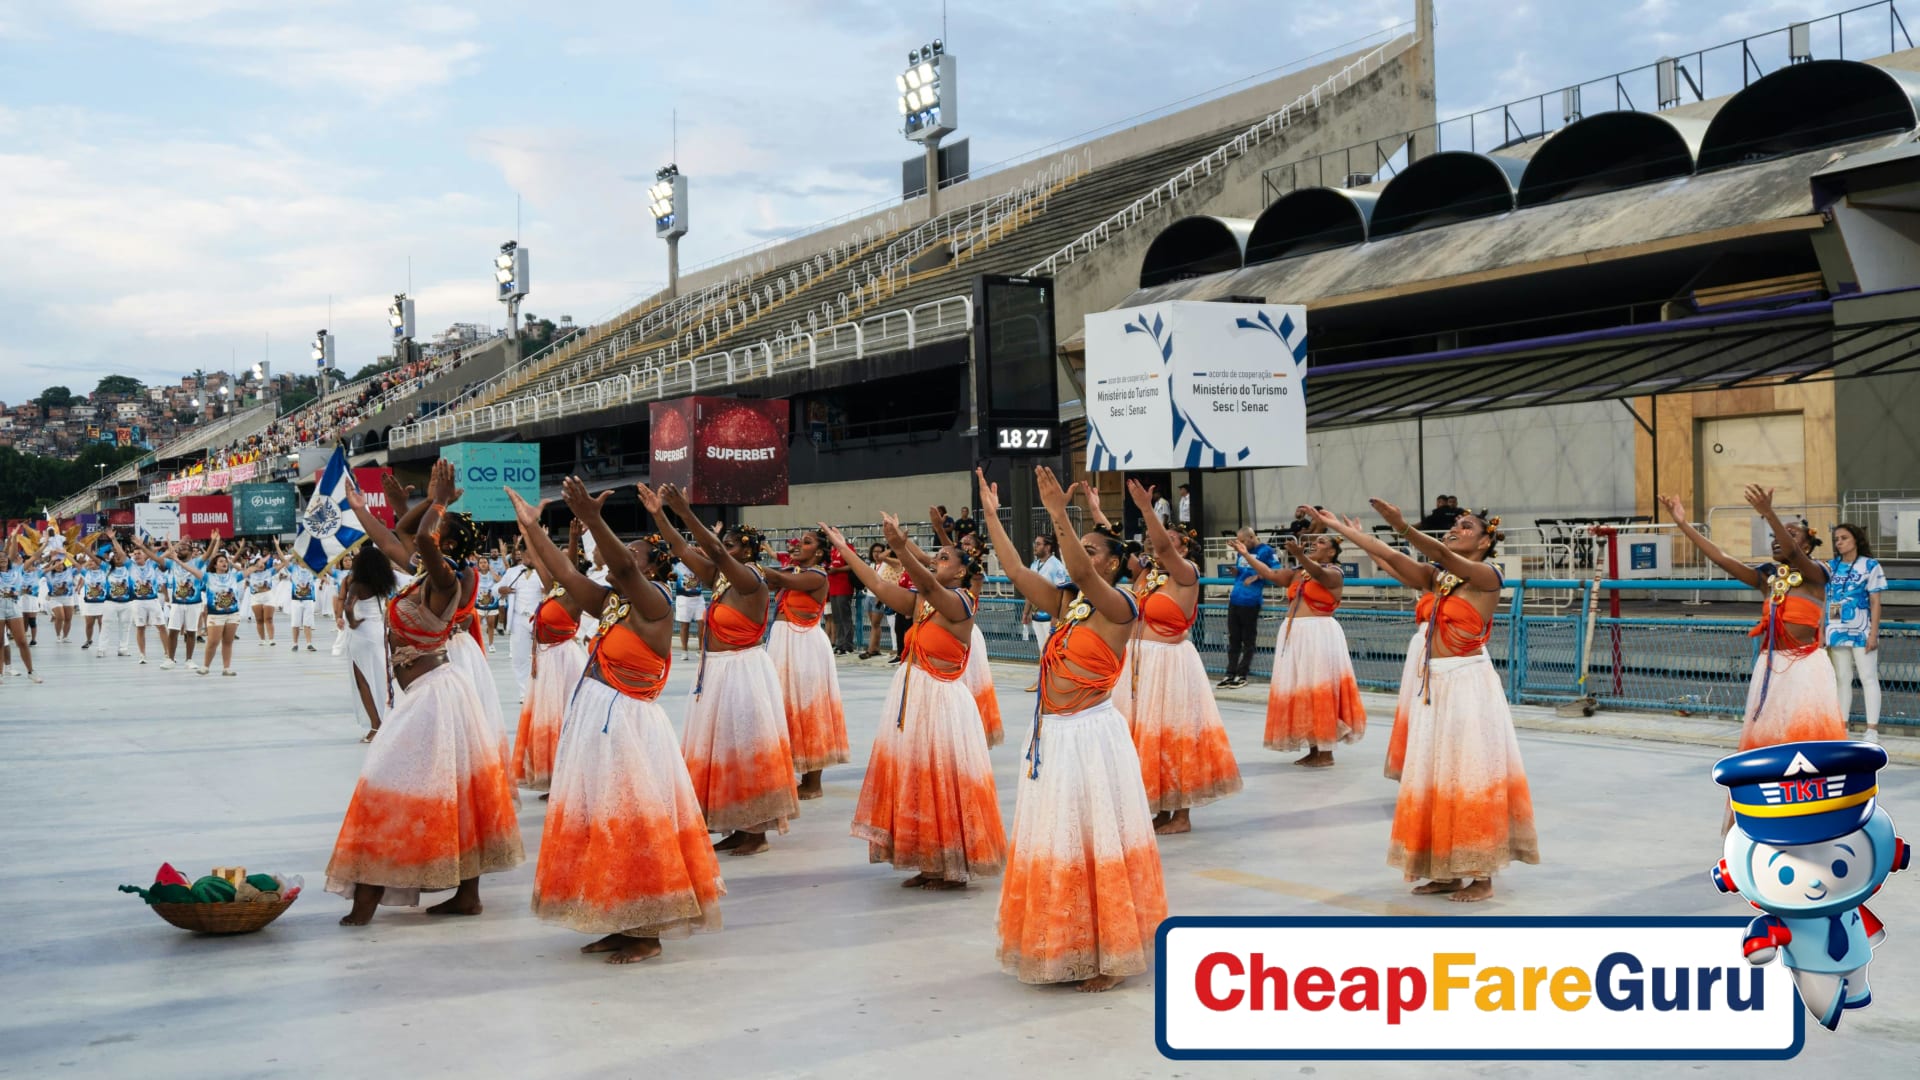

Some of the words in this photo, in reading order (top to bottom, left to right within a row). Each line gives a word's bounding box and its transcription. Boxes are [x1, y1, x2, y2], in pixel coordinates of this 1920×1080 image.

[1209, 369, 1230, 378] acordo
[1231, 369, 1238, 378] de
[1239, 369, 1272, 380] cooperação
[1098, 388, 1127, 402] Ministério
[1128, 388, 1136, 399] do
[1136, 386, 1159, 399] Turismo
[1193, 383, 1238, 396] Ministério
[1239, 383, 1250, 395] do
[1252, 383, 1288, 396] Turismo
[1110, 406, 1125, 417] Sesc
[1128, 404, 1147, 416] Senac
[1213, 401, 1235, 412] Sesc
[1241, 401, 1269, 412] Senac
[1000, 429, 1022, 448] 18
[1026, 429, 1049, 448] 27
[655, 446, 688, 462] SUPERBET
[706, 446, 776, 461] SUPERBET
[503, 466, 536, 482] RIO
[264, 496, 286, 507] Light
[192, 512, 229, 524] BRAHMA
